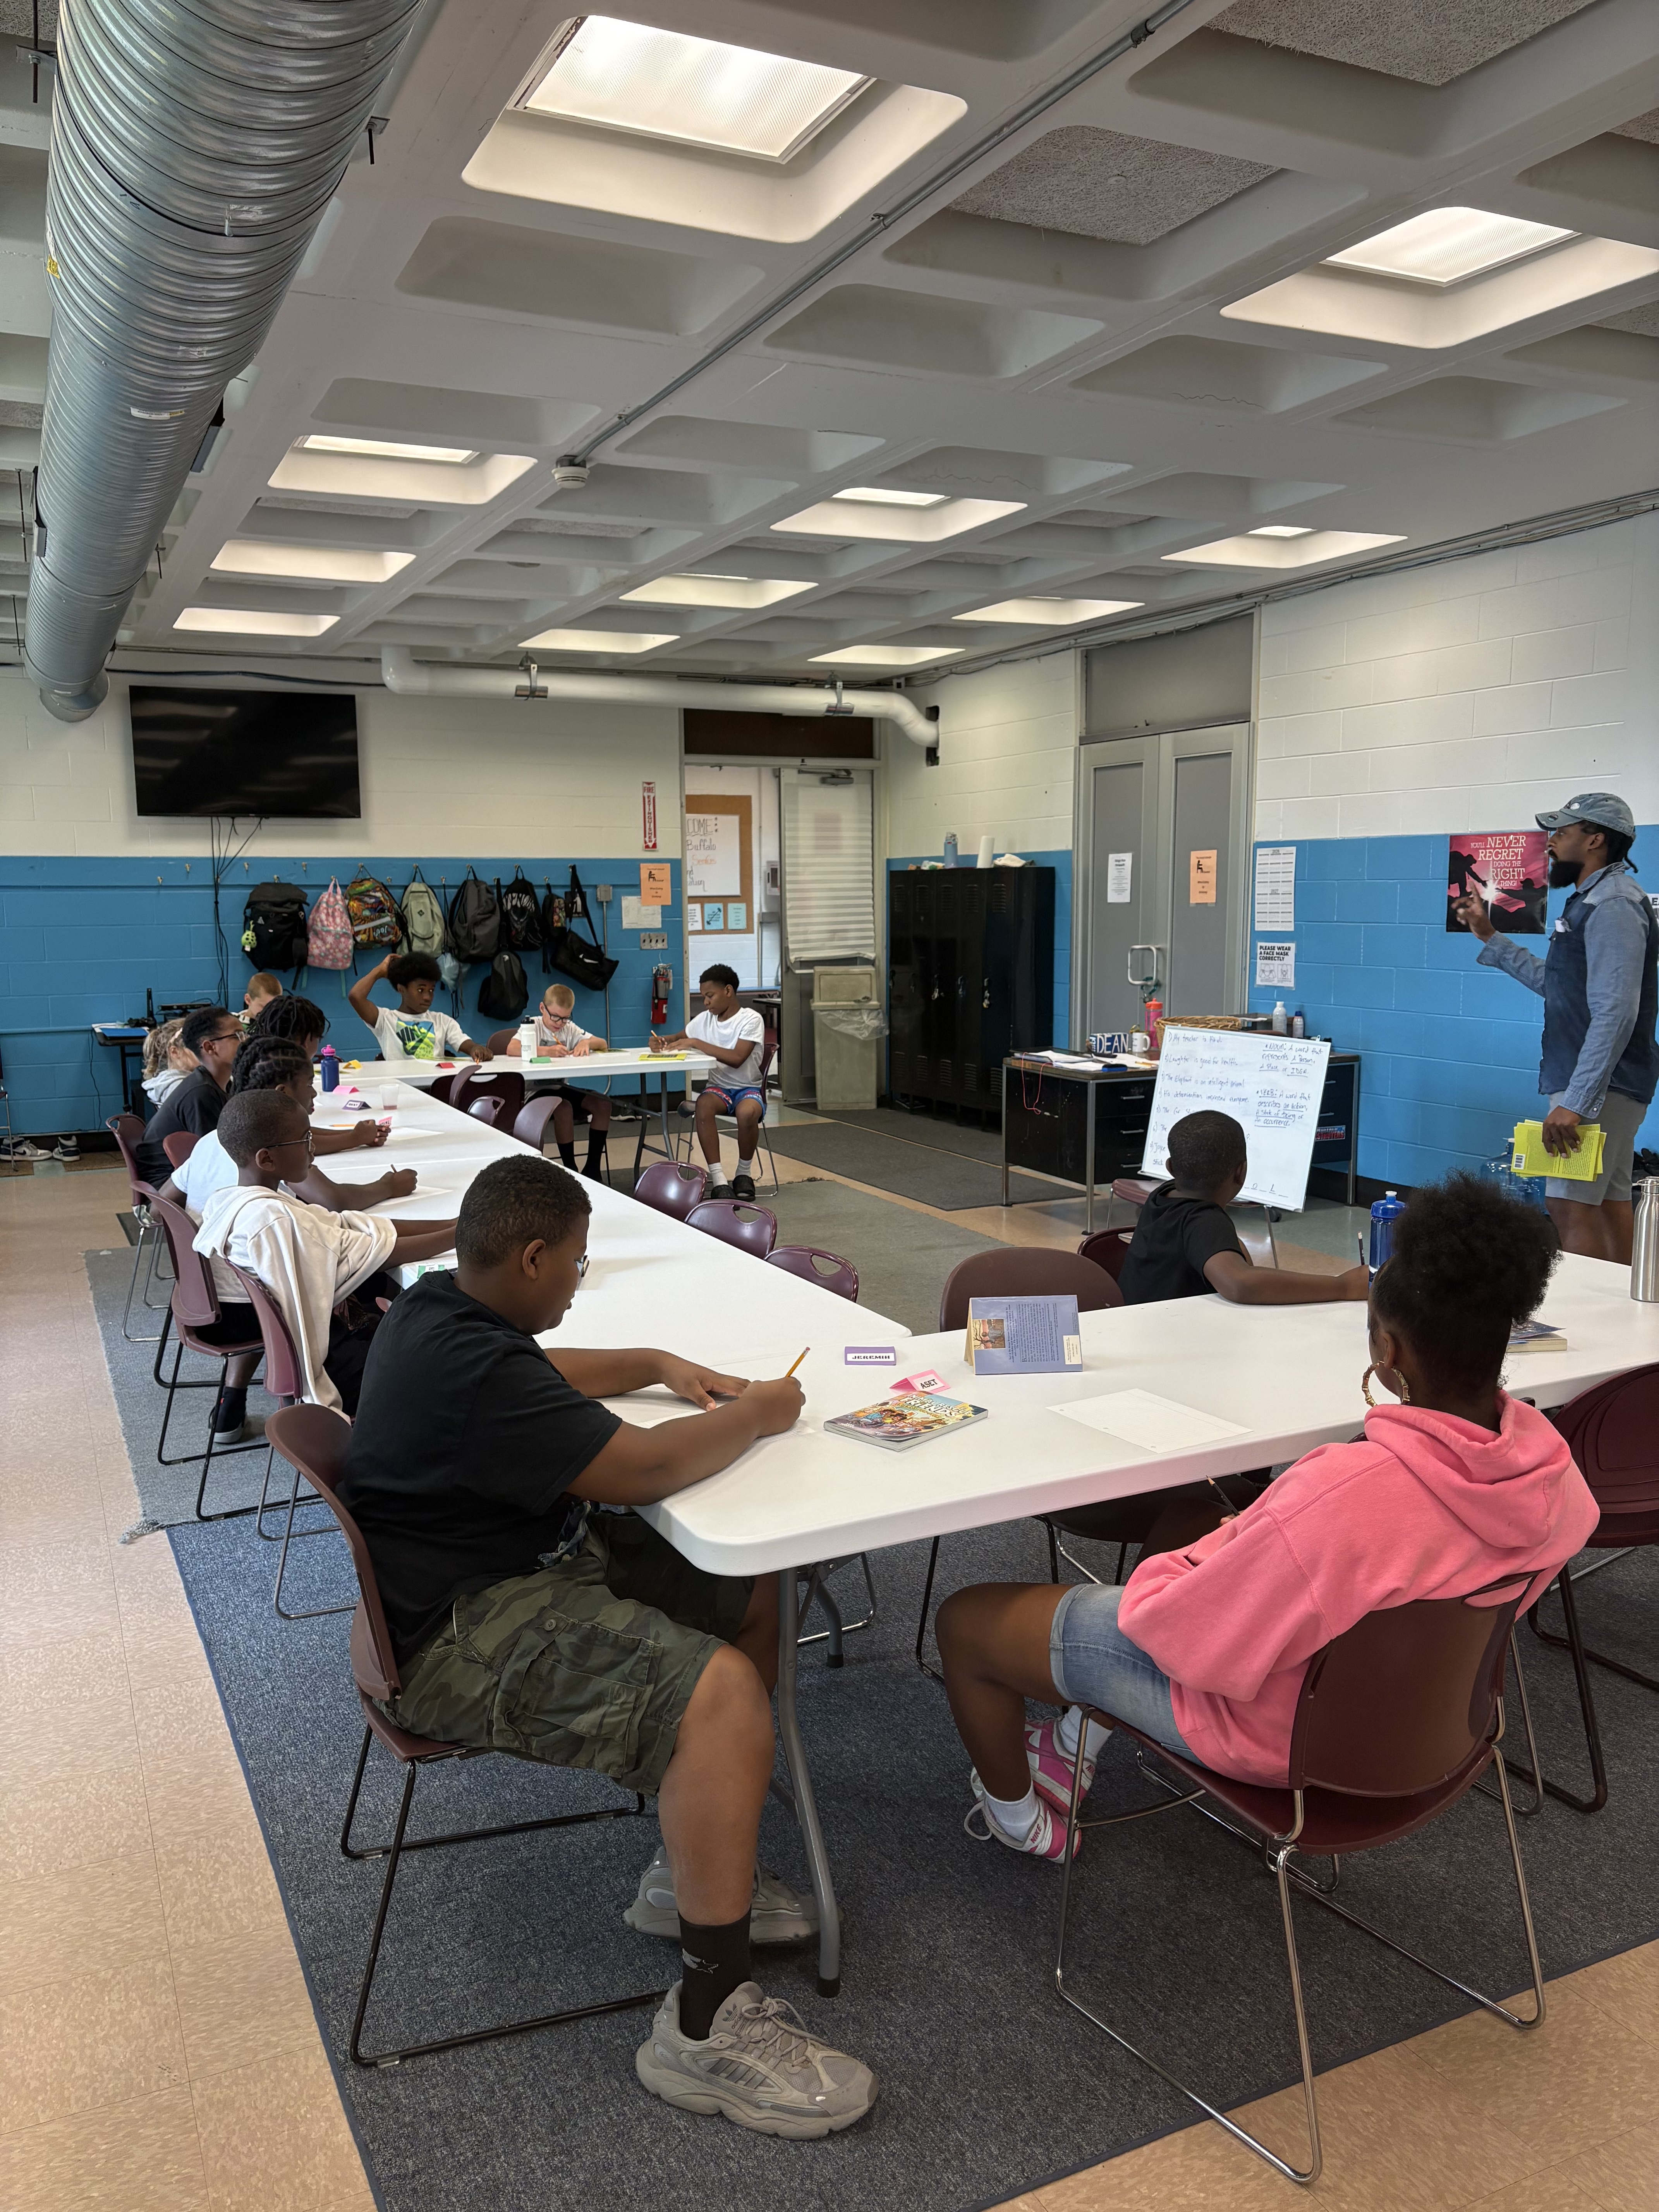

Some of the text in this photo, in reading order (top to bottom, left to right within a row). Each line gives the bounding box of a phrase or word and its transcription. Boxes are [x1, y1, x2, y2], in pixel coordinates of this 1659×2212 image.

[686, 838, 716, 850] Buffalo
[1486, 835, 1526, 848] NEVER
[1478, 848, 1523, 860] REGRET
[1492, 868, 1525, 879] RIGHT
[1097, 1033, 1128, 1053] DEAN
[1169, 1054, 1189, 1065] Laughter
[1200, 1056, 1211, 1068] good
[1262, 1053, 1288, 1061] represents
[1279, 1090, 1283, 1098] A
[1300, 1092, 1310, 1101] that
[920, 1379, 938, 1389] ASET
[900, 1397, 957, 1418] FRIENDS
[1030, 1824, 1042, 1844] NIKE
[732, 2013, 744, 2029] adida
